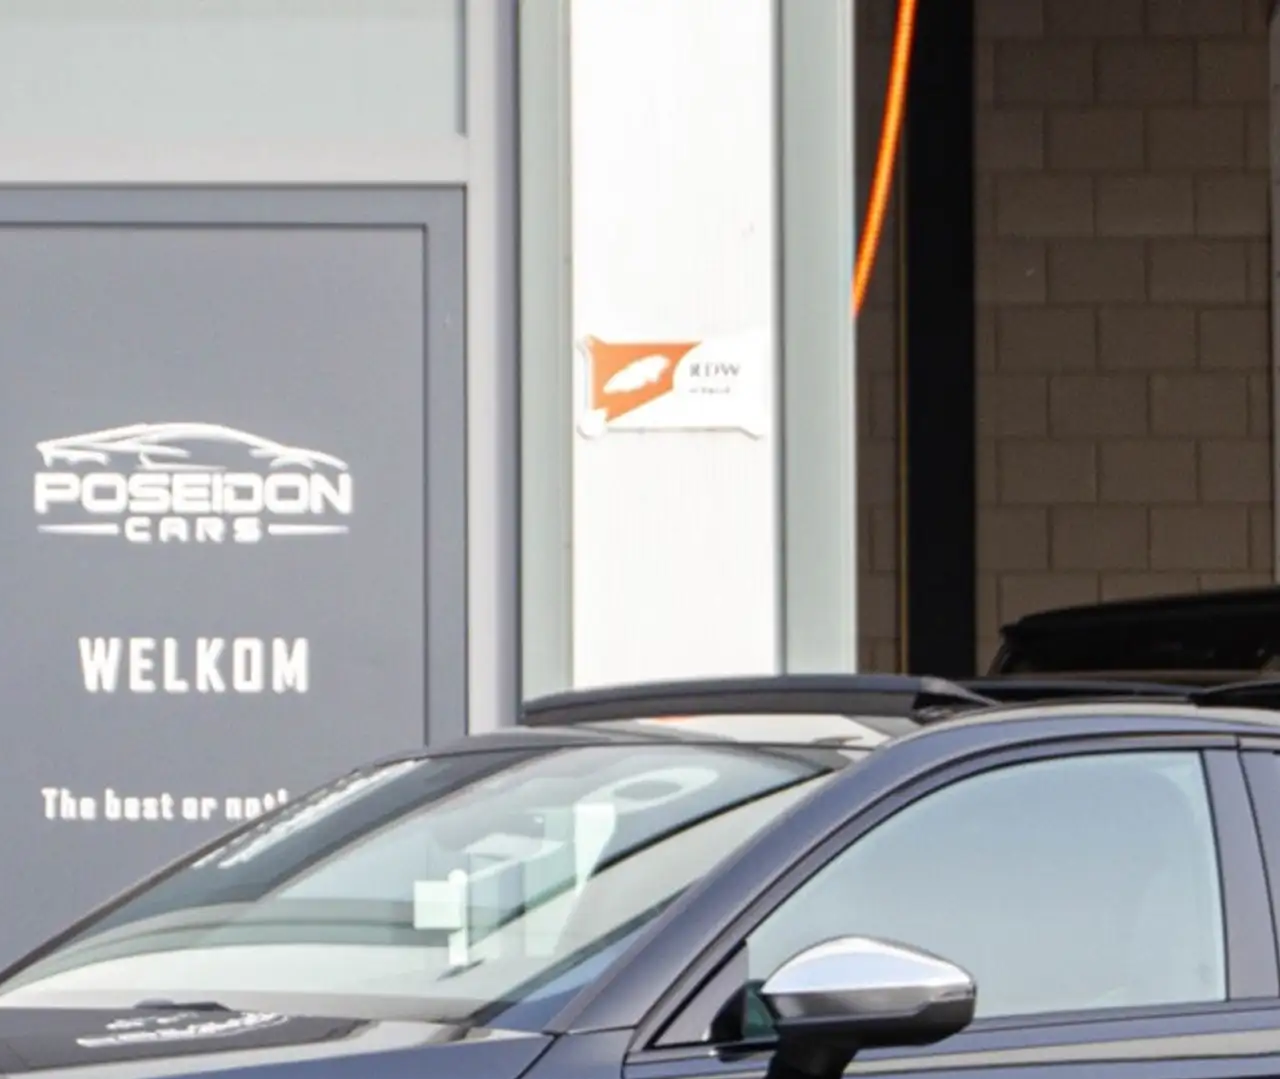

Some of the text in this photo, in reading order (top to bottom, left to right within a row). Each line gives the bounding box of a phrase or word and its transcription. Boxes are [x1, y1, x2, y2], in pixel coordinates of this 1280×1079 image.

[33, 471, 354, 516] POSEIDON
[124, 515, 263, 544] CARS
[77, 635, 311, 694] WELKOM
[40, 787, 97, 821] The
[103, 787, 174, 821] best
[180, 795, 219, 821] or
